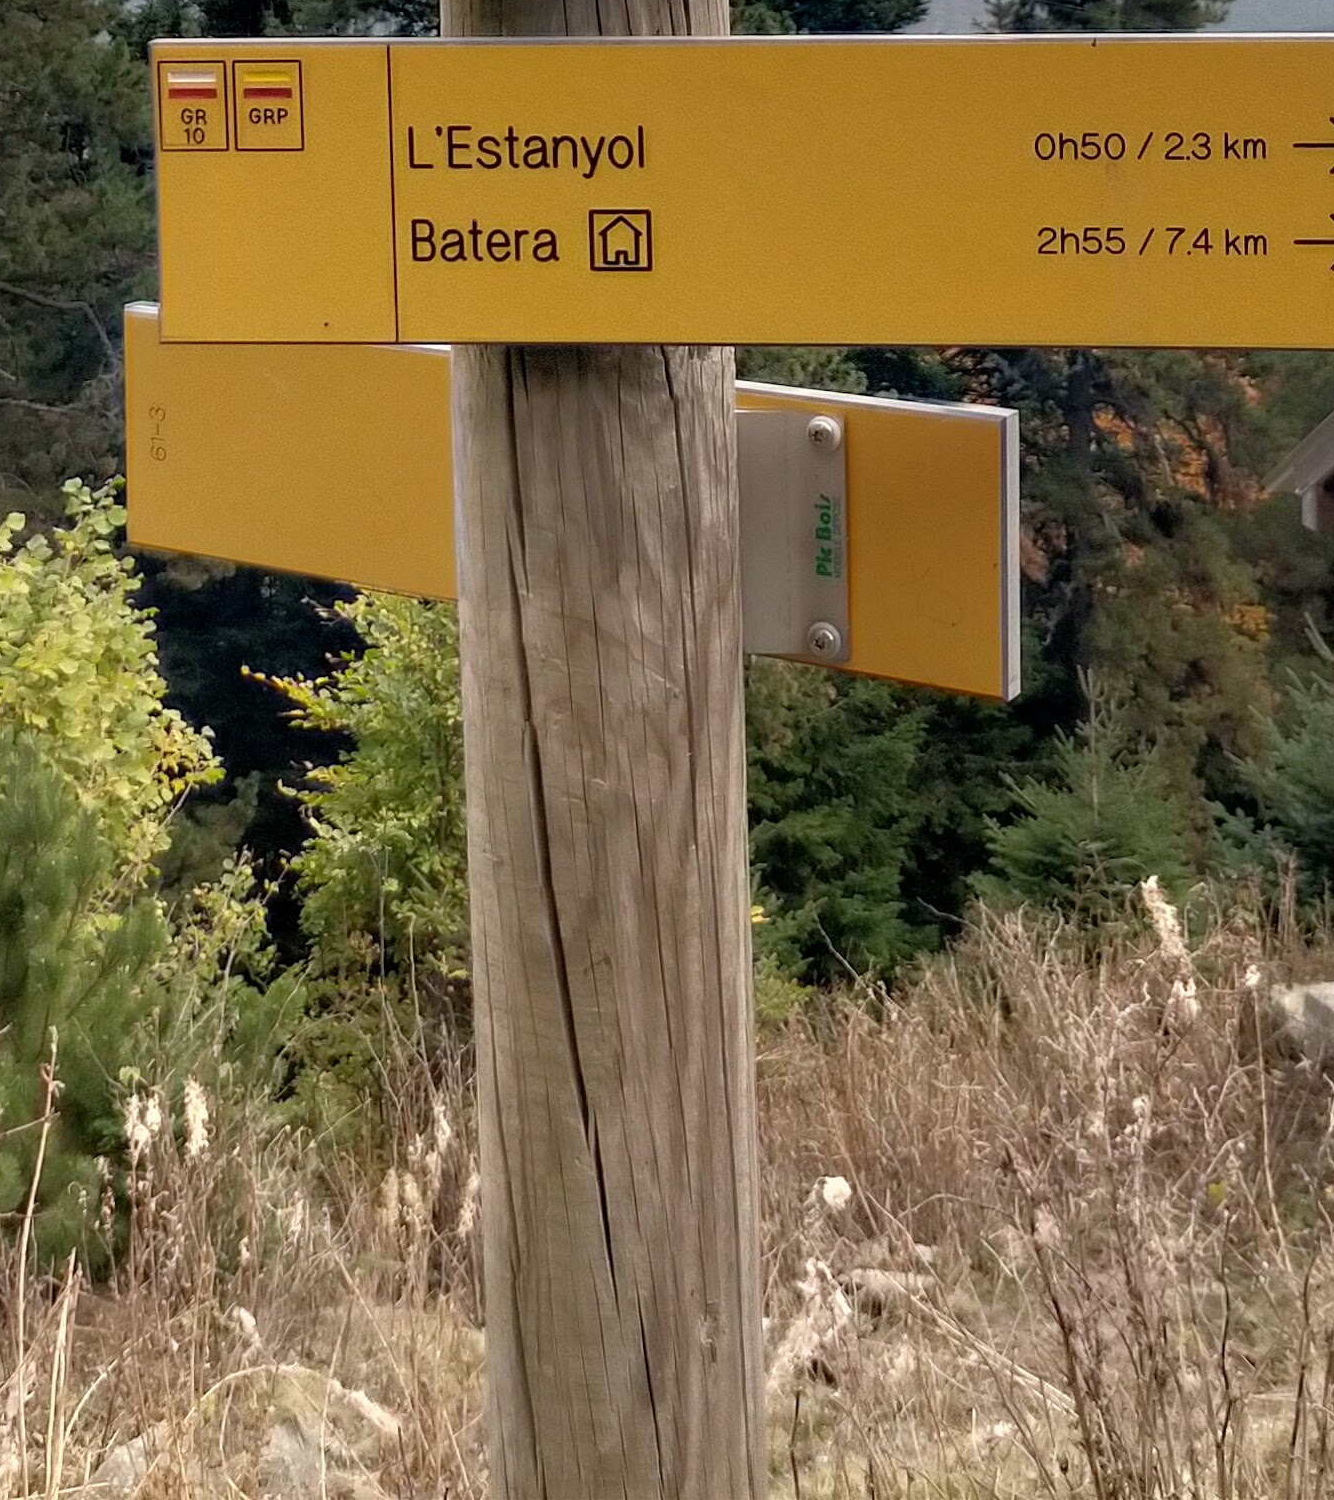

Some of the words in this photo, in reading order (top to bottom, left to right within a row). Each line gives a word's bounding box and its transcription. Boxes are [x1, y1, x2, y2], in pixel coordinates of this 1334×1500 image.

[180, 107, 208, 126] GR
[248, 107, 289, 125] GRP
[183, 127, 206, 146] 10
[407, 124, 645, 180] L'Estanyol
[1034, 131, 1126, 161] 0h50
[1137, 131, 1154, 160] /
[1164, 131, 1212, 161] 2.3
[1223, 131, 1267, 160] km
[410, 218, 561, 263] Batera
[1037, 226, 1126, 255] 2h55
[1138, 227, 1155, 256] /
[1165, 227, 1214, 256] 7.4
[1224, 227, 1268, 257] km
[814, 493, 832, 541] Bois
[815, 545, 833, 577] Pic
